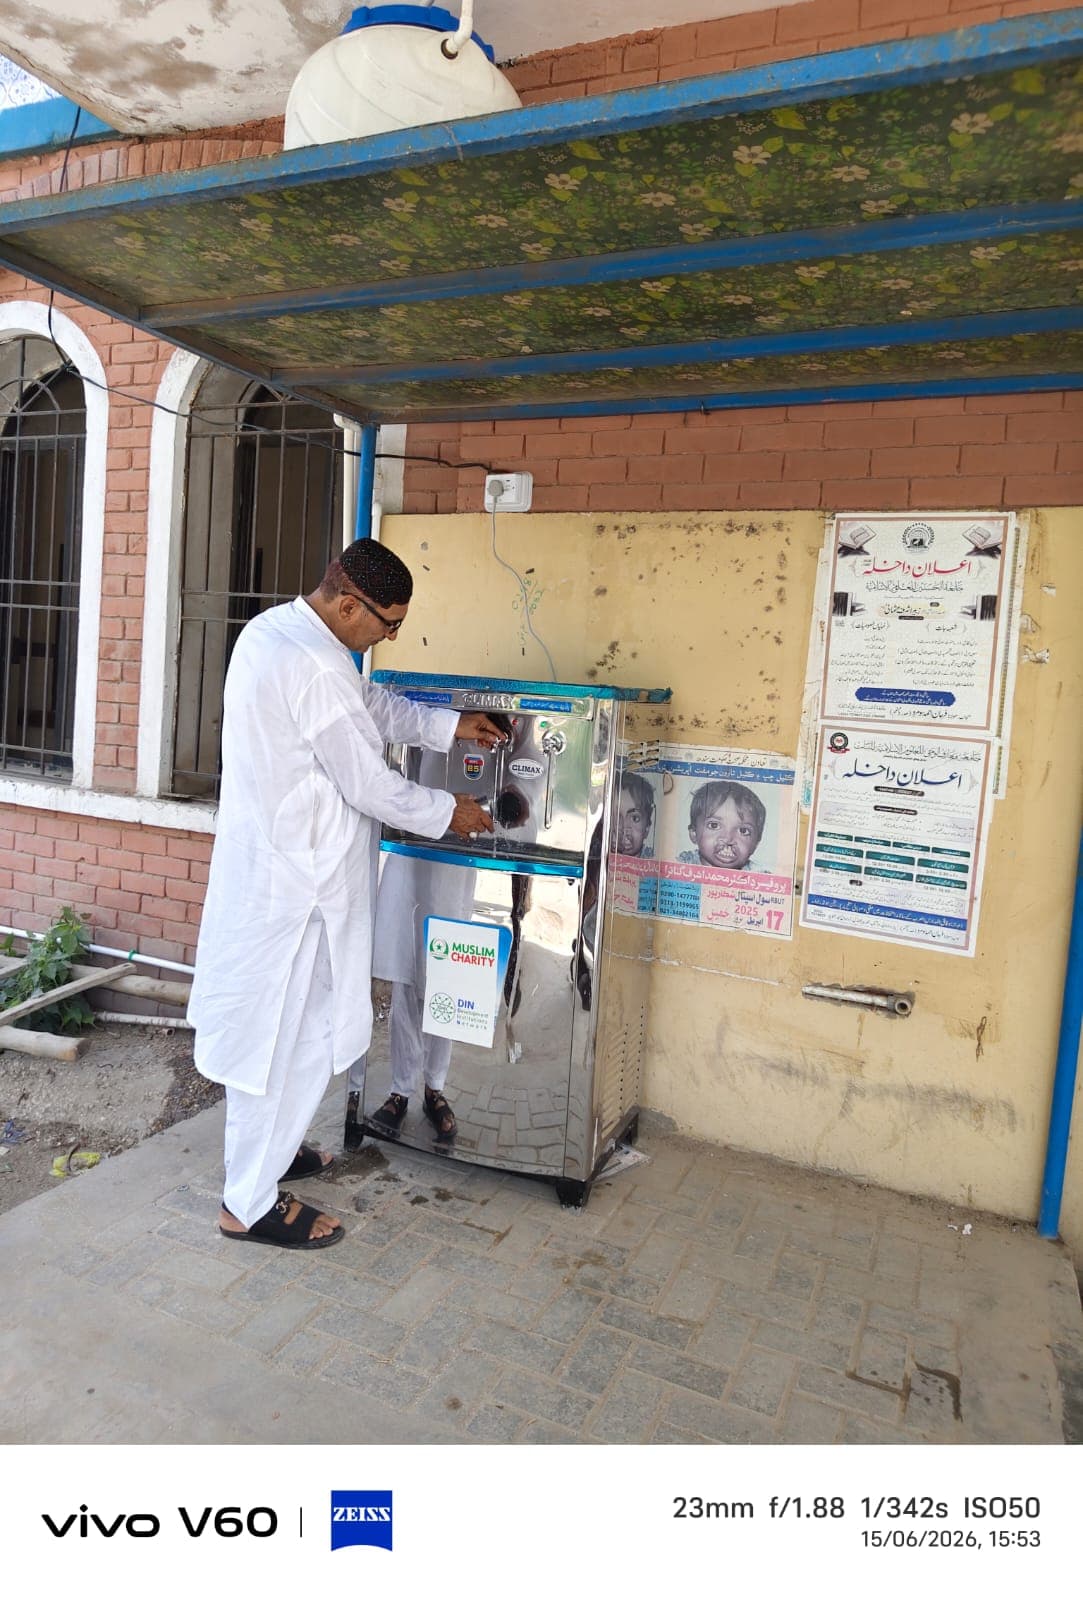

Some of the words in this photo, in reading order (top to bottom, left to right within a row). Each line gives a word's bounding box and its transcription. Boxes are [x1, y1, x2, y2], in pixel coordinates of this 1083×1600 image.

[863, 556, 911, 575] داخلہ
[912, 559, 972, 578] اعلان
[511, 764, 541, 774] CLIMAX
[842, 757, 896, 783] داخلہ
[897, 767, 962, 789] اعلان
[734, 904, 759, 916] 2025
[766, 910, 785, 931] 17
[452, 942, 495, 958] MUSLIM
[451, 951, 496, 968] CHARITY
[457, 998, 475, 1010] DIN
